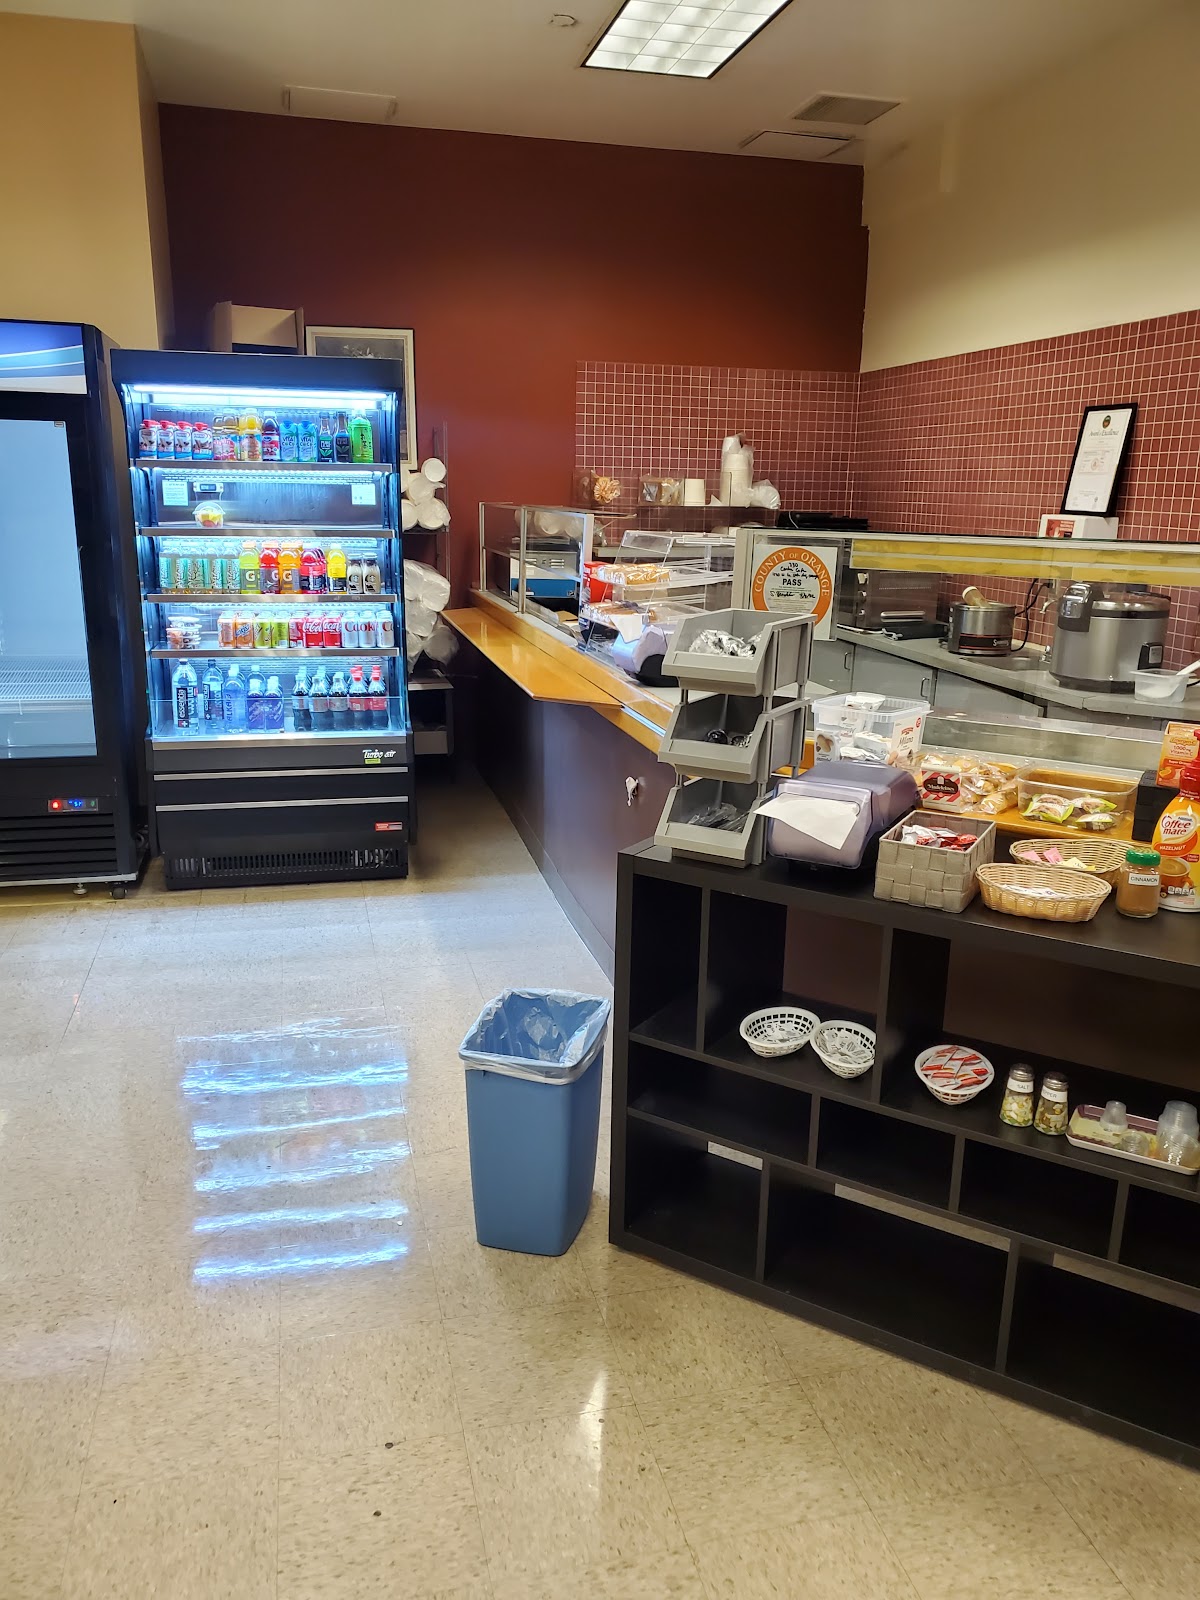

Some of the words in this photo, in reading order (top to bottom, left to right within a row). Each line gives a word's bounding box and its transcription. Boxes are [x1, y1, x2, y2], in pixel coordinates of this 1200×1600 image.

[245, 570, 255, 581] G
[282, 570, 292, 581] G
[754, 551, 786, 592] COUNTY
[801, 552, 830, 597] ORANGE
[782, 578, 802, 586] PASS
[177, 689, 187, 718] essentia
[362, 749, 384, 758] Turbo
[384, 750, 397, 758] air
[1162, 815, 1191, 829] Coffee
[1163, 828, 1187, 836] mate
